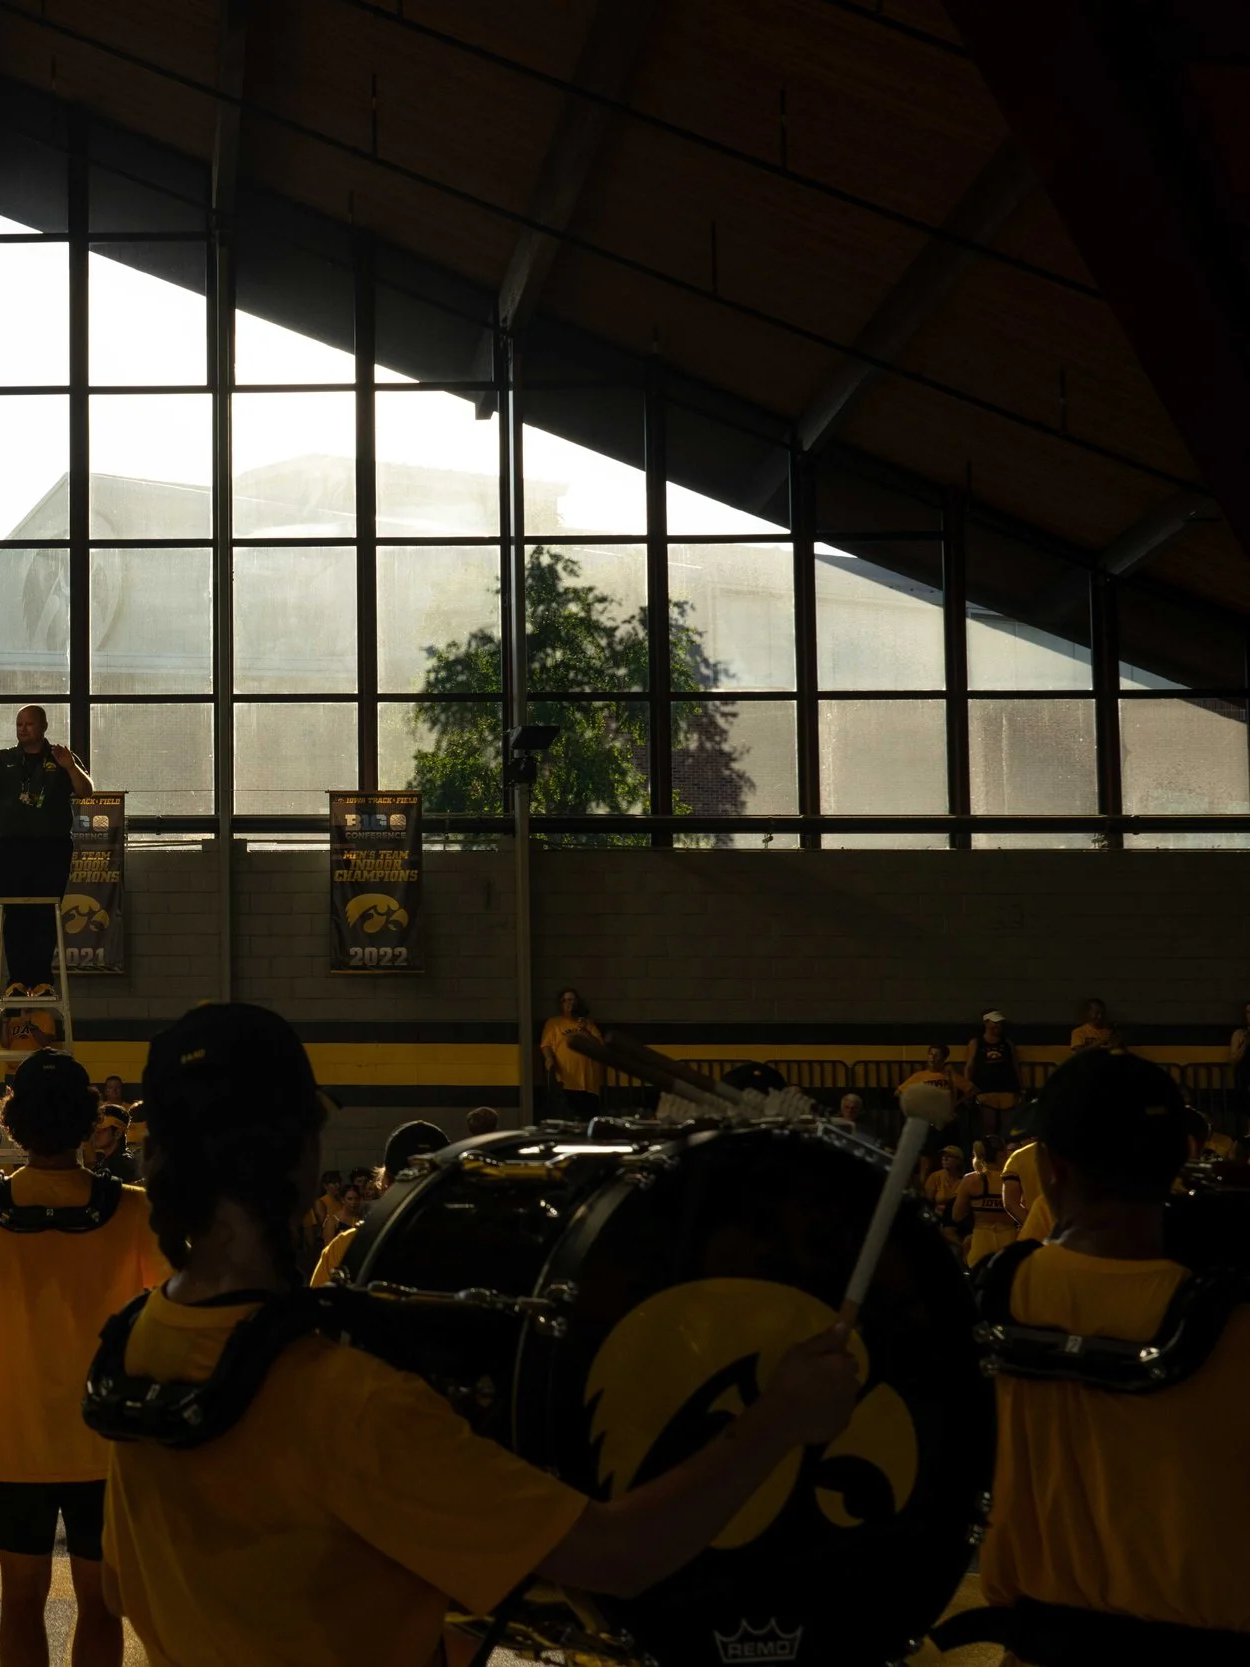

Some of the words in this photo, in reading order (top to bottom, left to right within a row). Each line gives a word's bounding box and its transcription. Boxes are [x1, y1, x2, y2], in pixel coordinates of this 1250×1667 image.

[72, 832, 109, 841] ERENCE
[345, 831, 407, 840] CONFERENCE
[81, 851, 112, 860] TEAM
[378, 850, 410, 860] TEAM
[71, 860, 110, 871] DOOR
[350, 859, 404, 870] INDOOR
[69, 870, 121, 883] MPIONS
[333, 869, 419, 882] CHAMPIONS
[66, 947, 105, 966] 021
[349, 947, 408, 966] 2022
[727, 1640, 792, 1657] REMO
